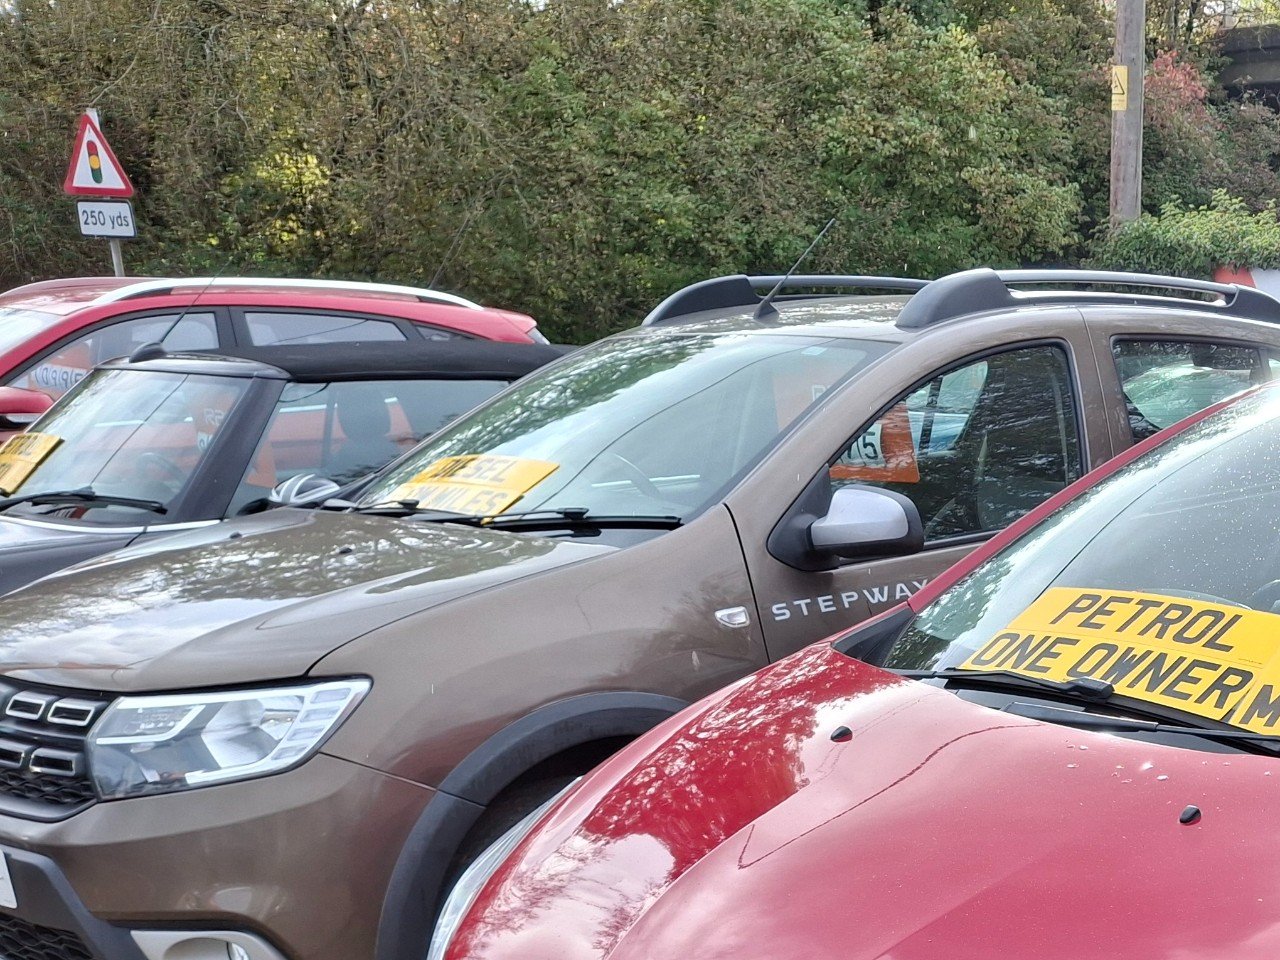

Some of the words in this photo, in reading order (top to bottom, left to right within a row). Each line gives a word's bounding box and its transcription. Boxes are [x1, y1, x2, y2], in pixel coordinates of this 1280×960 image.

[81, 209, 106, 226] 250
[109, 211, 130, 230] yds
[771, 579, 929, 621] STEPWAY
[1050, 593, 1243, 652] PETROL
[970, 632, 1080, 673] ONE
[1065, 642, 1255, 710] OWNER
